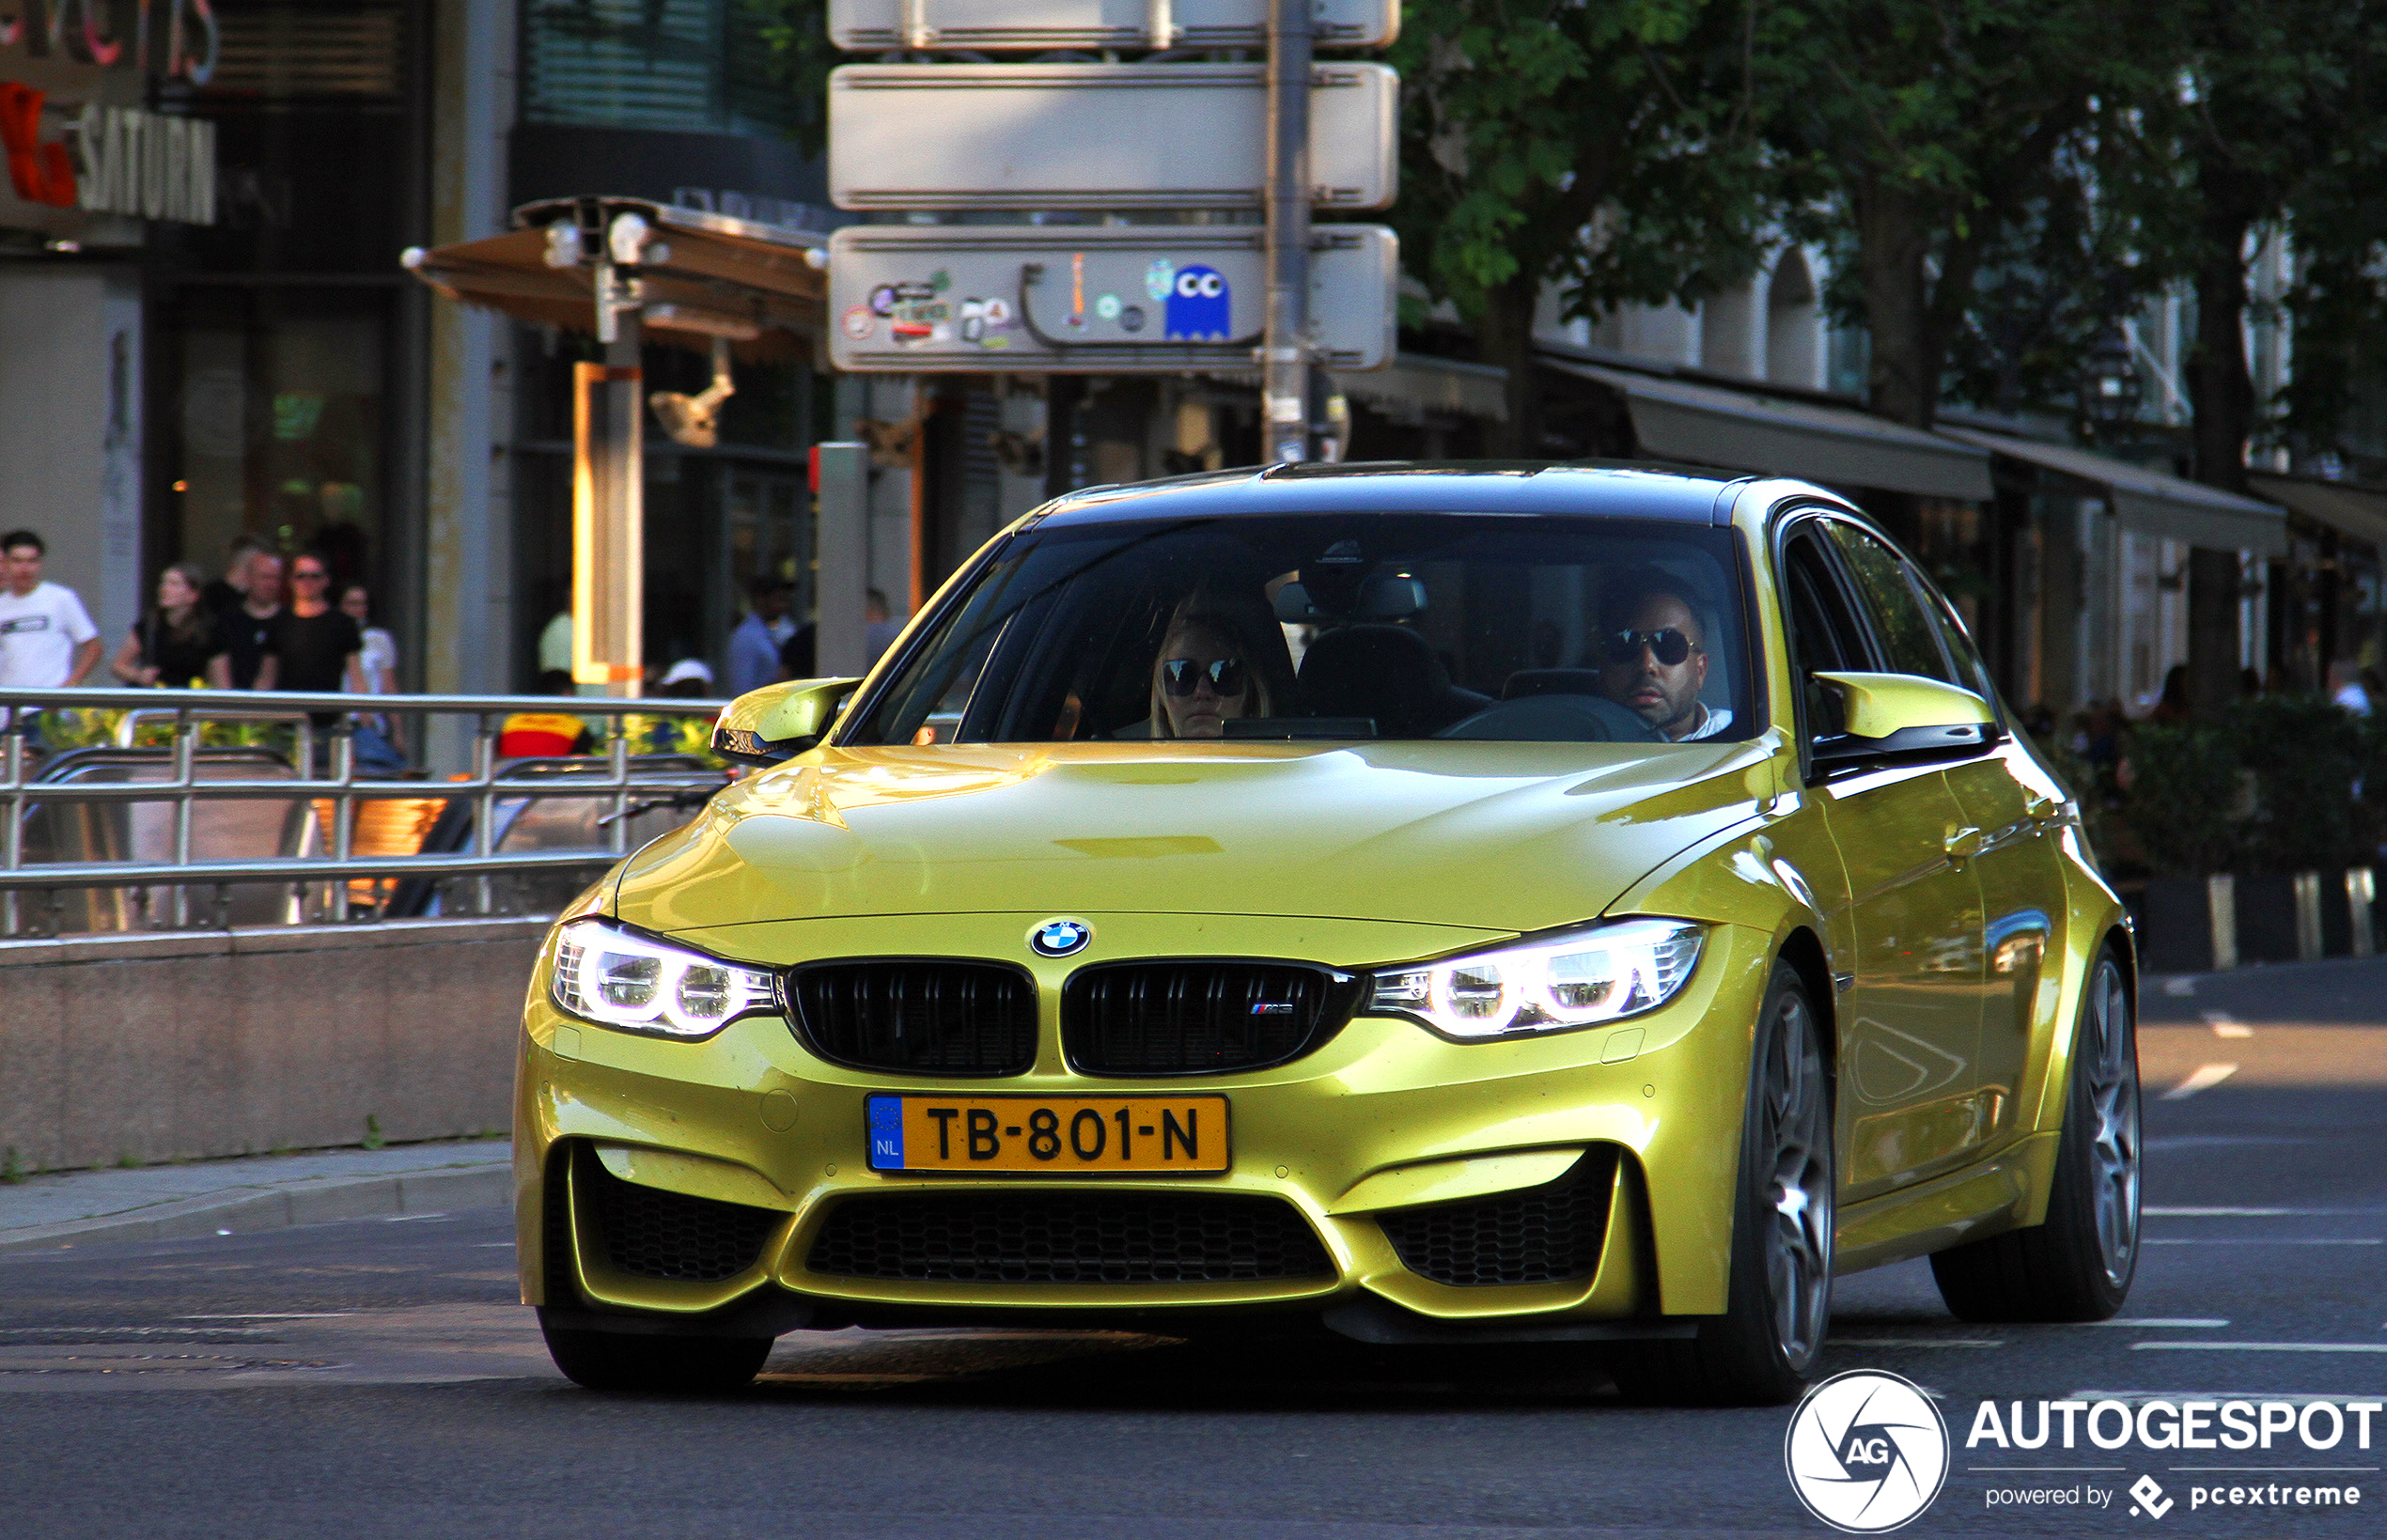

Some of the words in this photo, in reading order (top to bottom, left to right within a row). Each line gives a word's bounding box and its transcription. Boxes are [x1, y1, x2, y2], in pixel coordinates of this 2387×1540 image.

[77, 103, 217, 227] SATURN
[876, 1140, 899, 1157] NL
[927, 1107, 1199, 1161] TB-801-N
